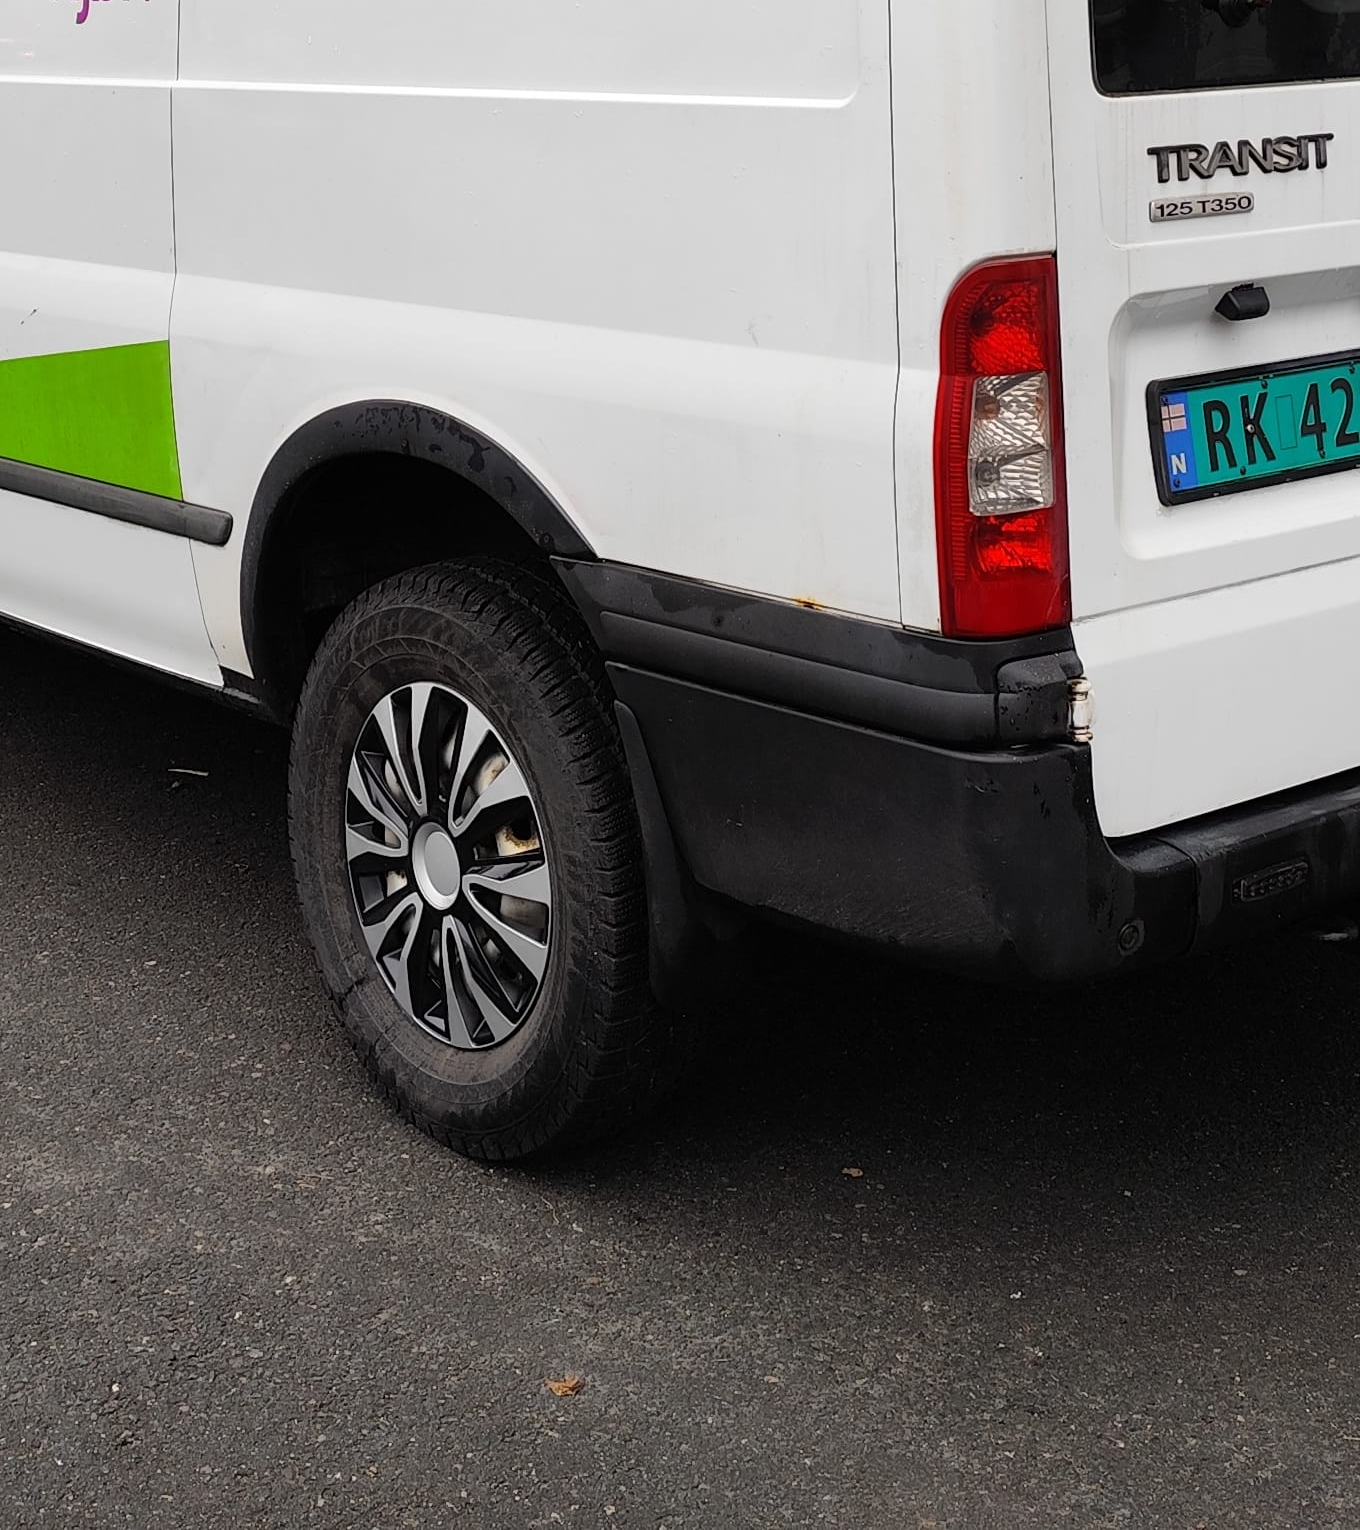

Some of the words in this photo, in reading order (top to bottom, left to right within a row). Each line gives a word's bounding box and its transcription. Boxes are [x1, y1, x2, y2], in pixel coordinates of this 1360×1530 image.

[1147, 133, 1334, 183] TRANSIT
[1155, 201, 1193, 217] 125
[1197, 195, 1251, 213] T350
[1202, 391, 1277, 472] RK
[1170, 452, 1187, 476] N
